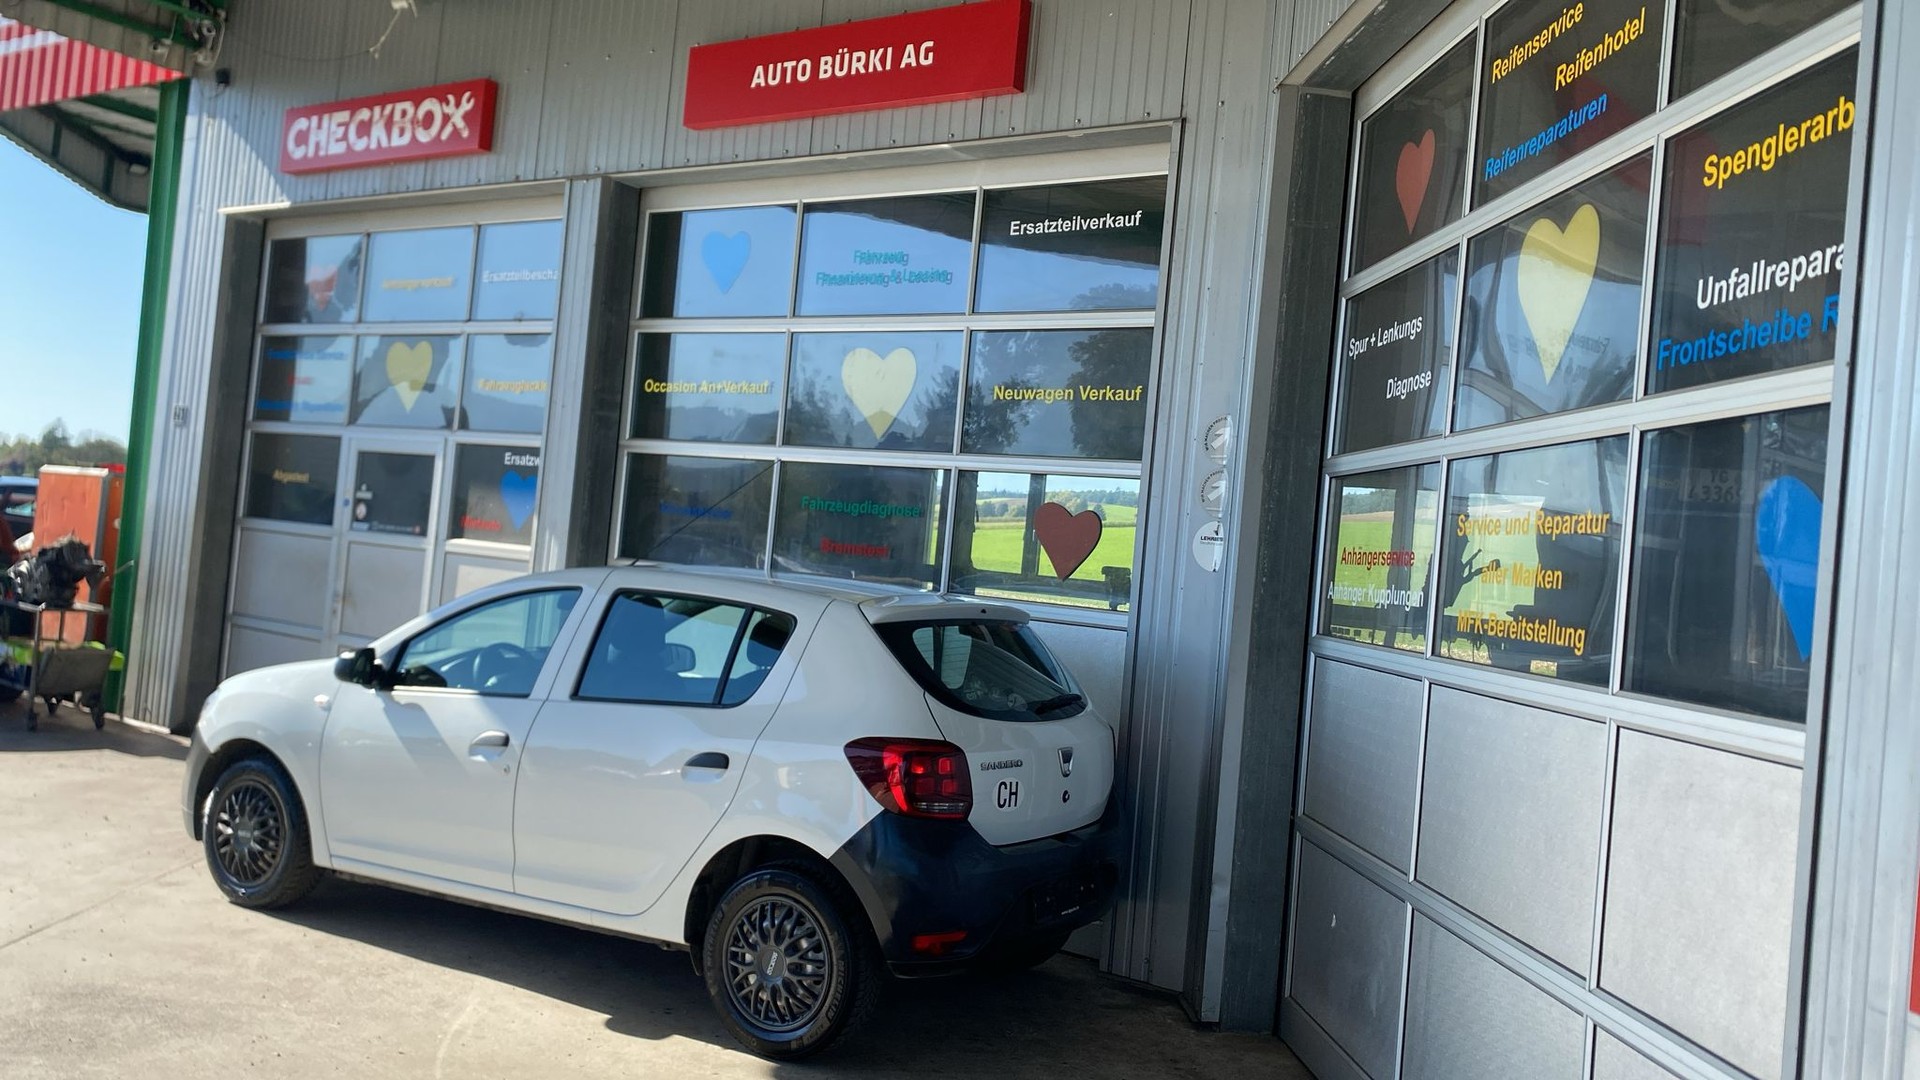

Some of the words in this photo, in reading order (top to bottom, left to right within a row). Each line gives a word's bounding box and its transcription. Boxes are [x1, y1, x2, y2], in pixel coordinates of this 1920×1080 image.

[1492, 1, 1584, 84] Reifenservice
[1555, 6, 1646, 91] Reifenhotel
[750, 59, 811, 88] AUTO
[818, 47, 893, 79] BÜRKI
[899, 41, 934, 68] AG
[287, 91, 475, 160] CHECKBOX
[1485, 92, 1608, 182] Reifenreparaturen
[1703, 96, 1855, 190] Spenglerarb
[1009, 210, 1142, 236] Ersatzteilverkauf
[1696, 242, 1844, 310] Unfallrepara
[1349, 336, 1369, 360] Spur
[1377, 316, 1423, 340] Lenkungs
[1657, 306, 1812, 371] Frontscheibe
[644, 379, 697, 393] Occasion
[700, 379, 770, 394] An+Verkauf
[993, 385, 1073, 404] Neuwagen
[1079, 385, 1142, 401] Verkauf
[1386, 370, 1432, 400] Diagnose
[801, 495, 922, 518] Fahrzeugdiagnose
[1457, 512, 1500, 537] Service
[1505, 511, 1530, 535] und
[1535, 509, 1610, 541] Reparatur
[1340, 547, 1415, 570] Anhängerservice
[1480, 561, 1507, 585] aller
[1512, 562, 1563, 589] Marken
[1368, 584, 1424, 611] Kupplungen
[1457, 609, 1586, 656] MFK-Bereitstellung
[980, 759, 1023, 771] SANDERO
[996, 781, 1019, 809] CH
